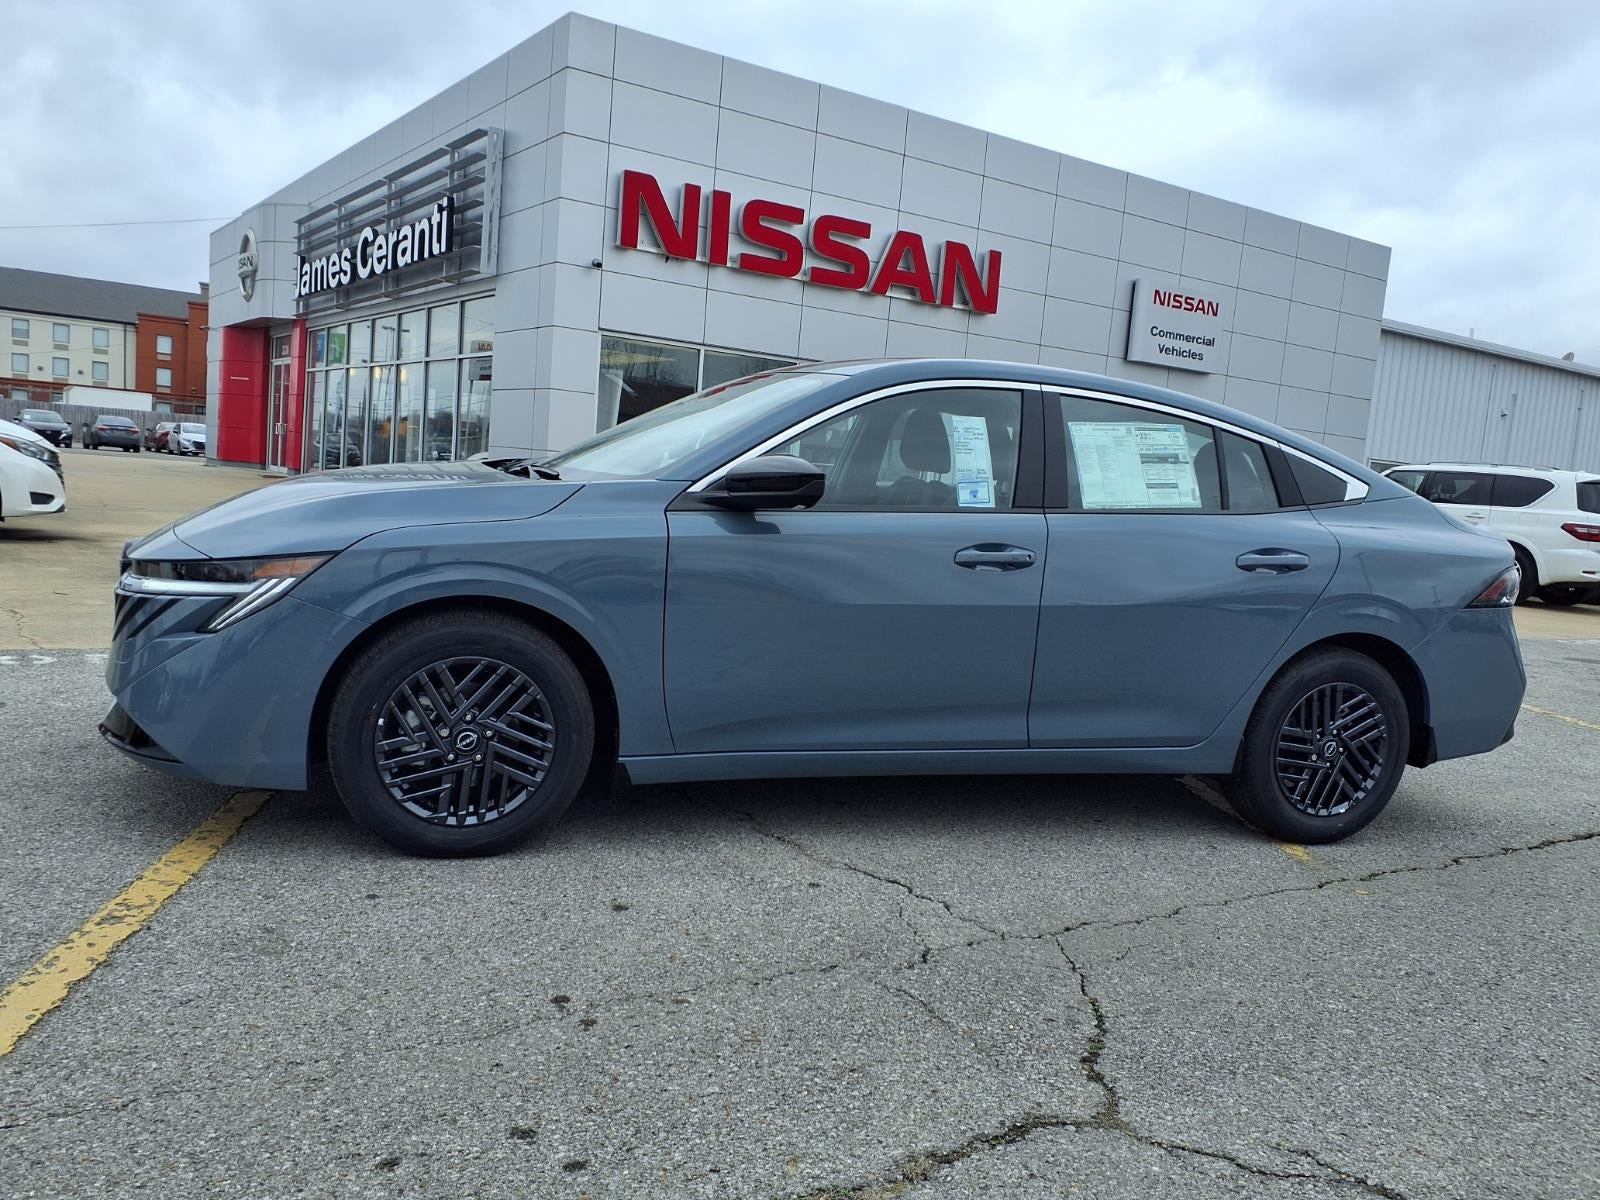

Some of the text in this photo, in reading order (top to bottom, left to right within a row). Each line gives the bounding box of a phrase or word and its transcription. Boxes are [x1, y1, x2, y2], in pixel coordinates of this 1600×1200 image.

[295, 198, 451, 298] James Ceranti
[617, 169, 1003, 315] NISSAN
[1153, 288, 1219, 317] NISSAN
[1150, 325, 1215, 347] Commercial
[1158, 343, 1204, 361] Vehicles
